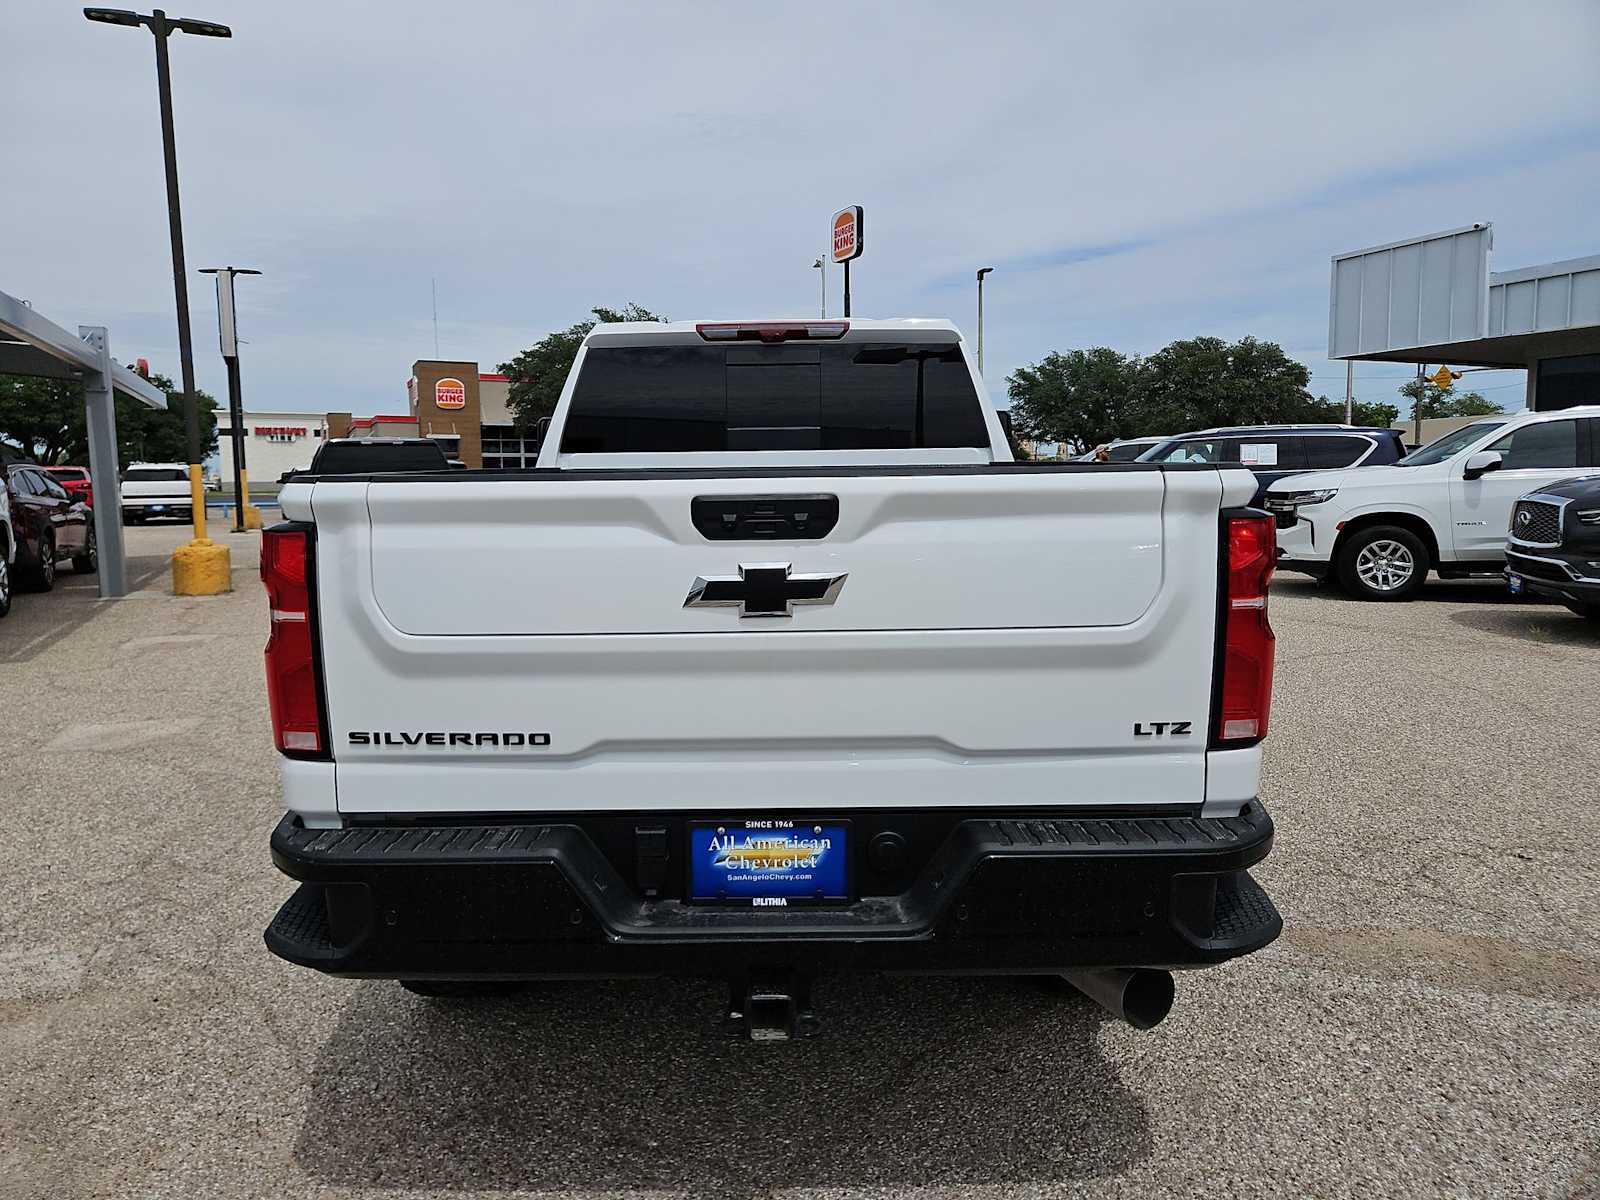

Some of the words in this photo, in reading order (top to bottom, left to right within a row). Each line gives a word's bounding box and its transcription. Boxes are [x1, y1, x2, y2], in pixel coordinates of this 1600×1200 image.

[834, 223, 854, 239] BURGER
[834, 232, 854, 251] KING
[437, 394, 464, 403] KING
[1133, 721, 1192, 736] LTZ
[349, 732, 551, 746] SILVERADO
[745, 820, 772, 828] SINCE
[775, 820, 794, 828] 1946
[708, 835, 735, 851] All
[743, 835, 831, 850] American
[725, 854, 817, 870] Chevrolet
[727, 873, 812, 882] SanAngeloChevy.com
[760, 897, 787, 906] LITHIA
